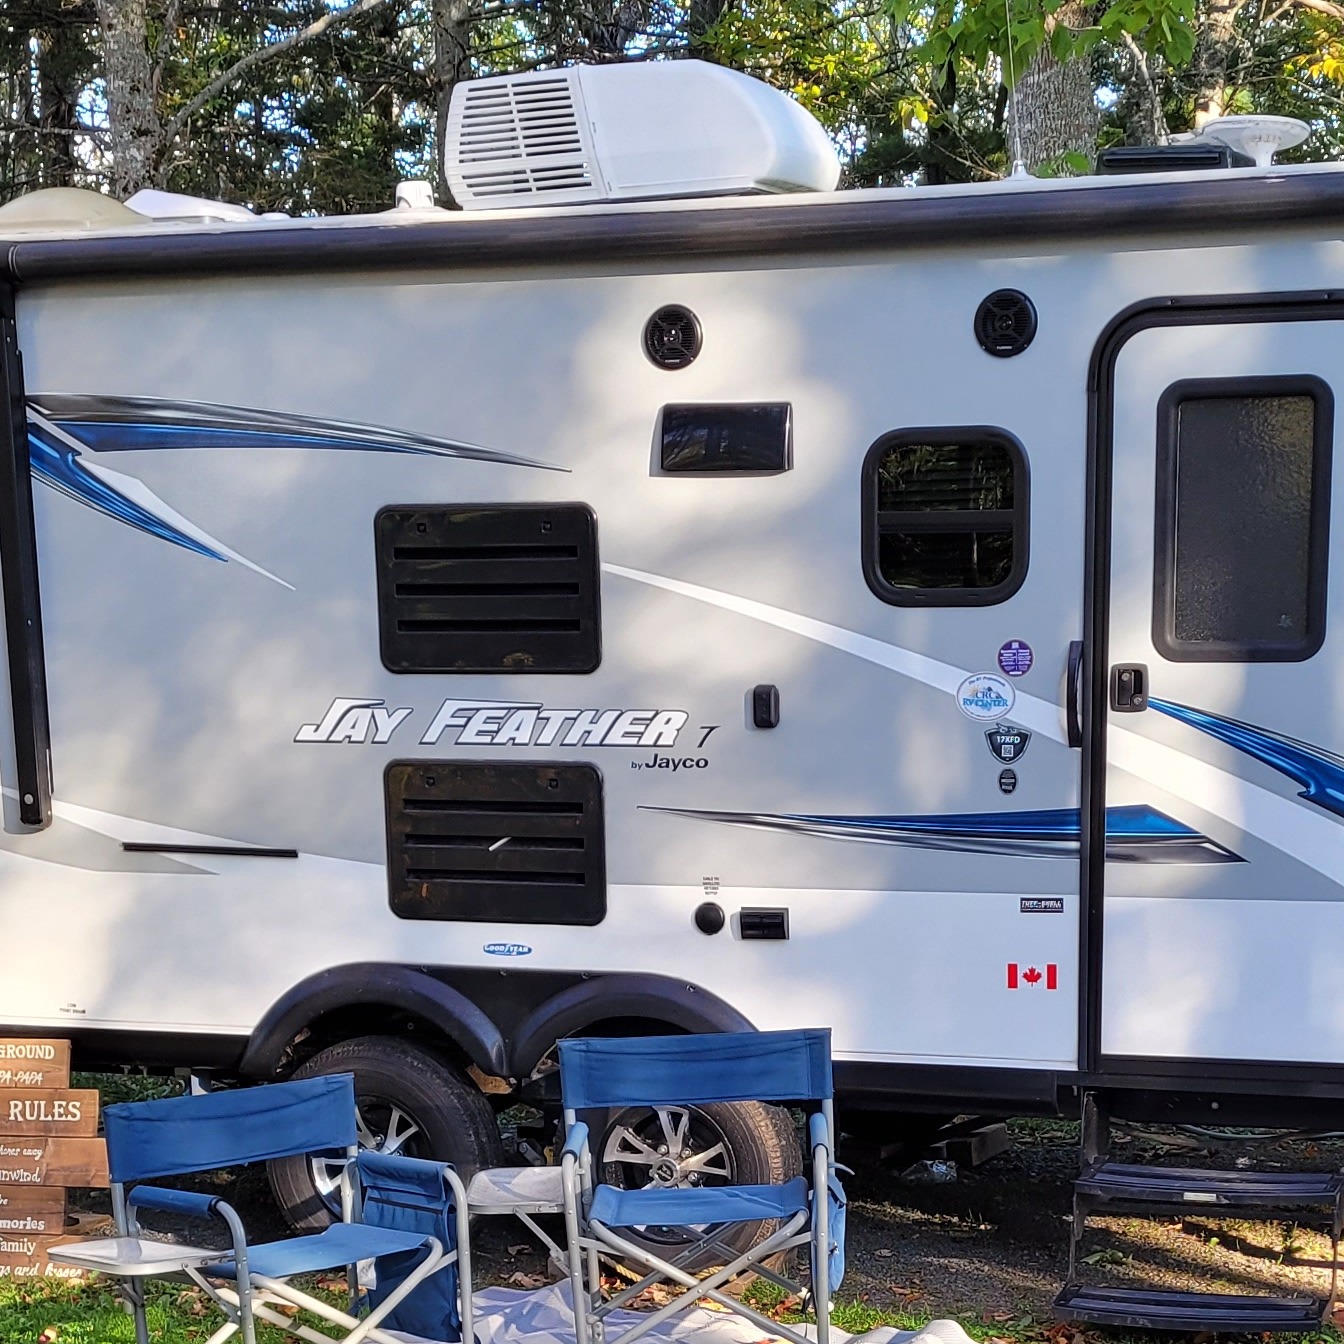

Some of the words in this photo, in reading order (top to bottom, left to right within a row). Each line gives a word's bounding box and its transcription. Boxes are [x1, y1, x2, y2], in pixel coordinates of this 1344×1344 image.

[963, 698, 974, 706] RV
[975, 690, 997, 700] CRC
[293, 697, 413, 744] JAY
[419, 698, 689, 748] FEATHER
[697, 724, 722, 748] 7
[630, 760, 643, 770] by
[644, 753, 709, 772] Jayco
[8, 1100, 81, 1121] RULES
[22, 1147, 44, 1160] away
[14, 1262, 41, 1277] and
[44, 1262, 83, 1278] kisses
